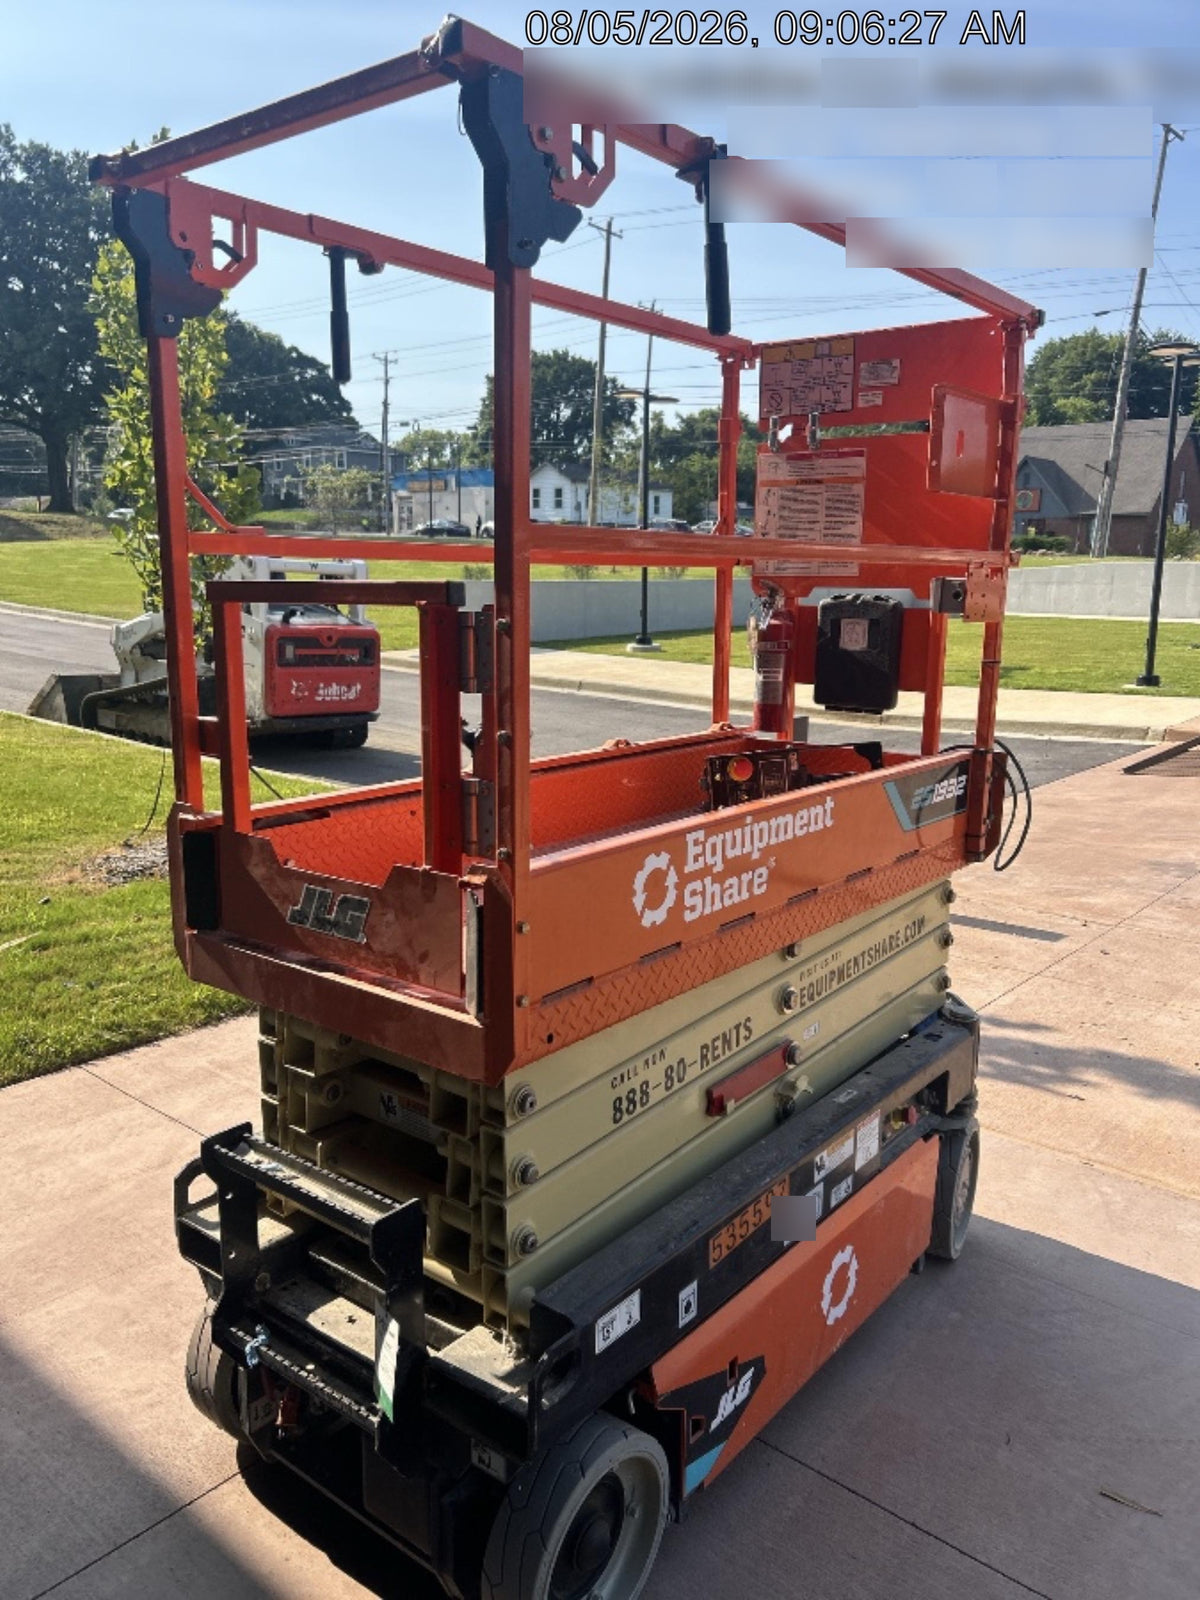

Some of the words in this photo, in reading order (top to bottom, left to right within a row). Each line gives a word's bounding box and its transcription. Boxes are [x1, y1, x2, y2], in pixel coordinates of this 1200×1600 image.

[684, 796, 835, 874] Equipment
[286, 883, 371, 943] JLG
[684, 866, 769, 924] Share
[799, 915, 926, 1008] EQUIPMENTSHARE.COM
[611, 1066, 638, 1089] CALL
[612, 1016, 753, 1124] 888-80-RENTS
[708, 1367, 755, 1433] JLG
